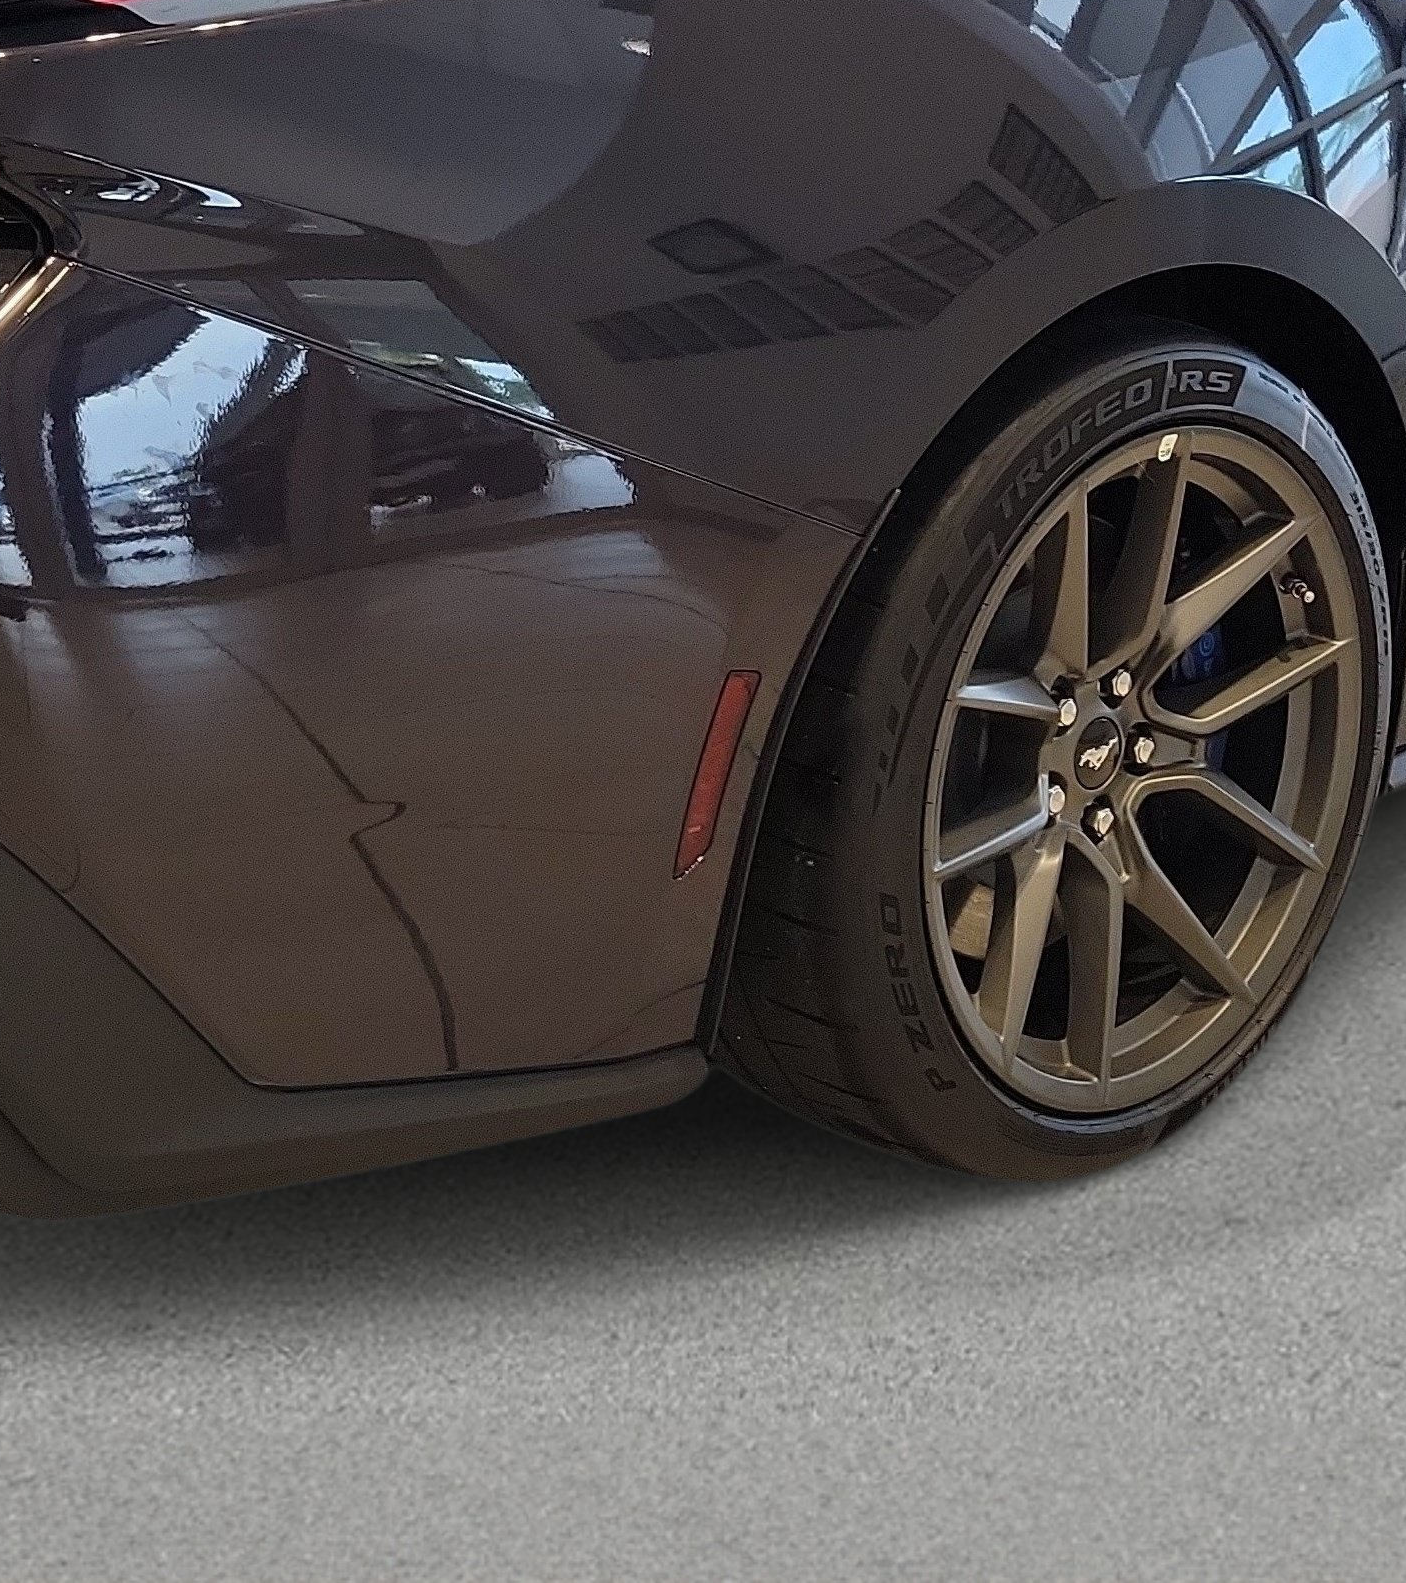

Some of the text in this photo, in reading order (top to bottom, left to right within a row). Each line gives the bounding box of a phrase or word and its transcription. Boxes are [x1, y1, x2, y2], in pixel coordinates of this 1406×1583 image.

[995, 370, 1234, 519] TROFEO RS
[879, 891, 958, 1093] P ZERO
